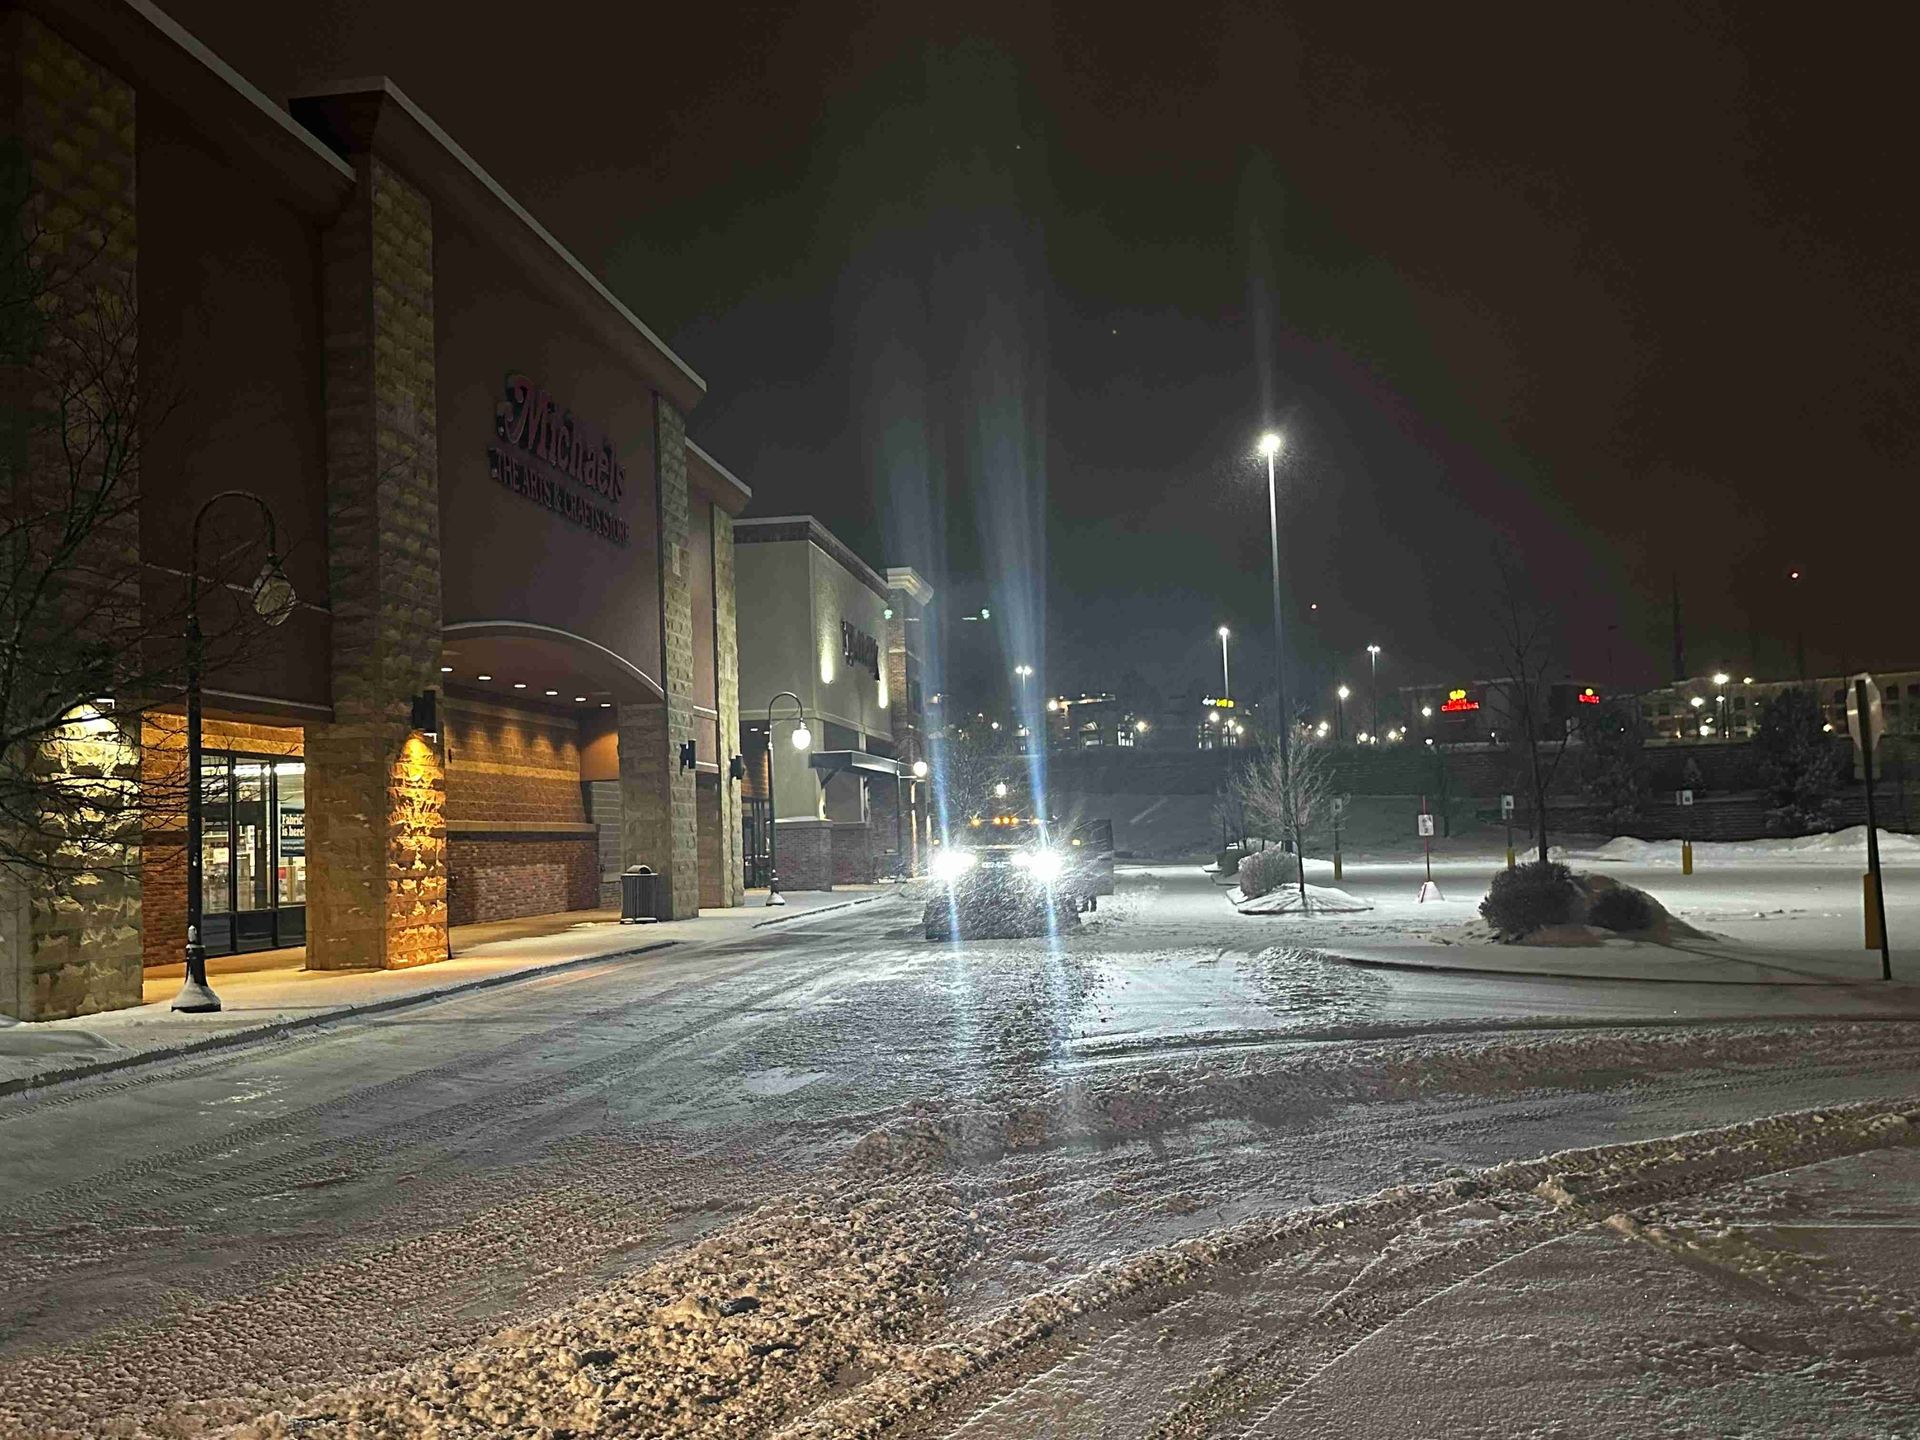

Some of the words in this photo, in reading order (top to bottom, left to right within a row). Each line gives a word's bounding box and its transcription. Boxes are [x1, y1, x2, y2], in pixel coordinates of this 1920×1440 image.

[497, 373, 626, 502] Michaels
[490, 448, 520, 492] THE
[522, 468, 553, 508] ARTS
[565, 492, 602, 533] CRAFTS
[602, 509, 629, 543] STORE
[282, 814, 303, 825] Fabric
[282, 826, 288, 837] is
